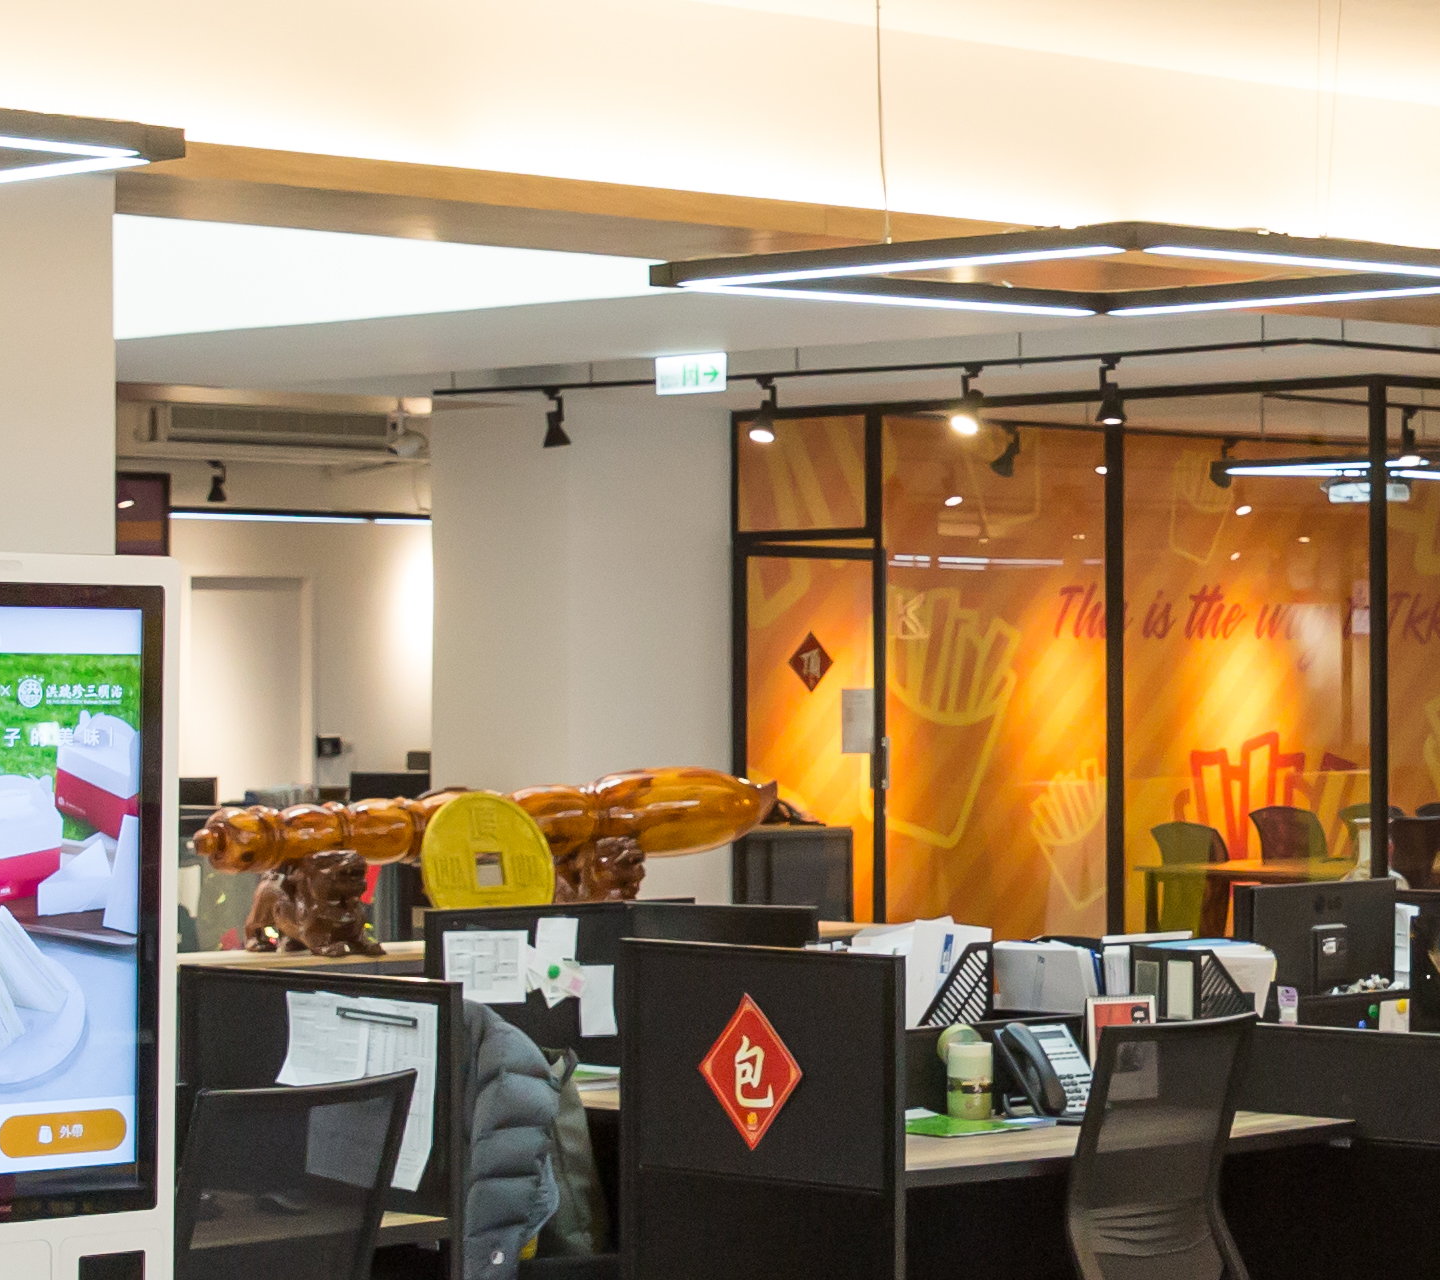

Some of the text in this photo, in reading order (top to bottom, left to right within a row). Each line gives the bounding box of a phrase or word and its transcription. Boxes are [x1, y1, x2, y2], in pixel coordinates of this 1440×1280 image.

[1142, 590, 1176, 640] is
[1184, 584, 1247, 641] the
[734, 1035, 774, 1109] 包
[59, 1124, 84, 1139] 外帶
